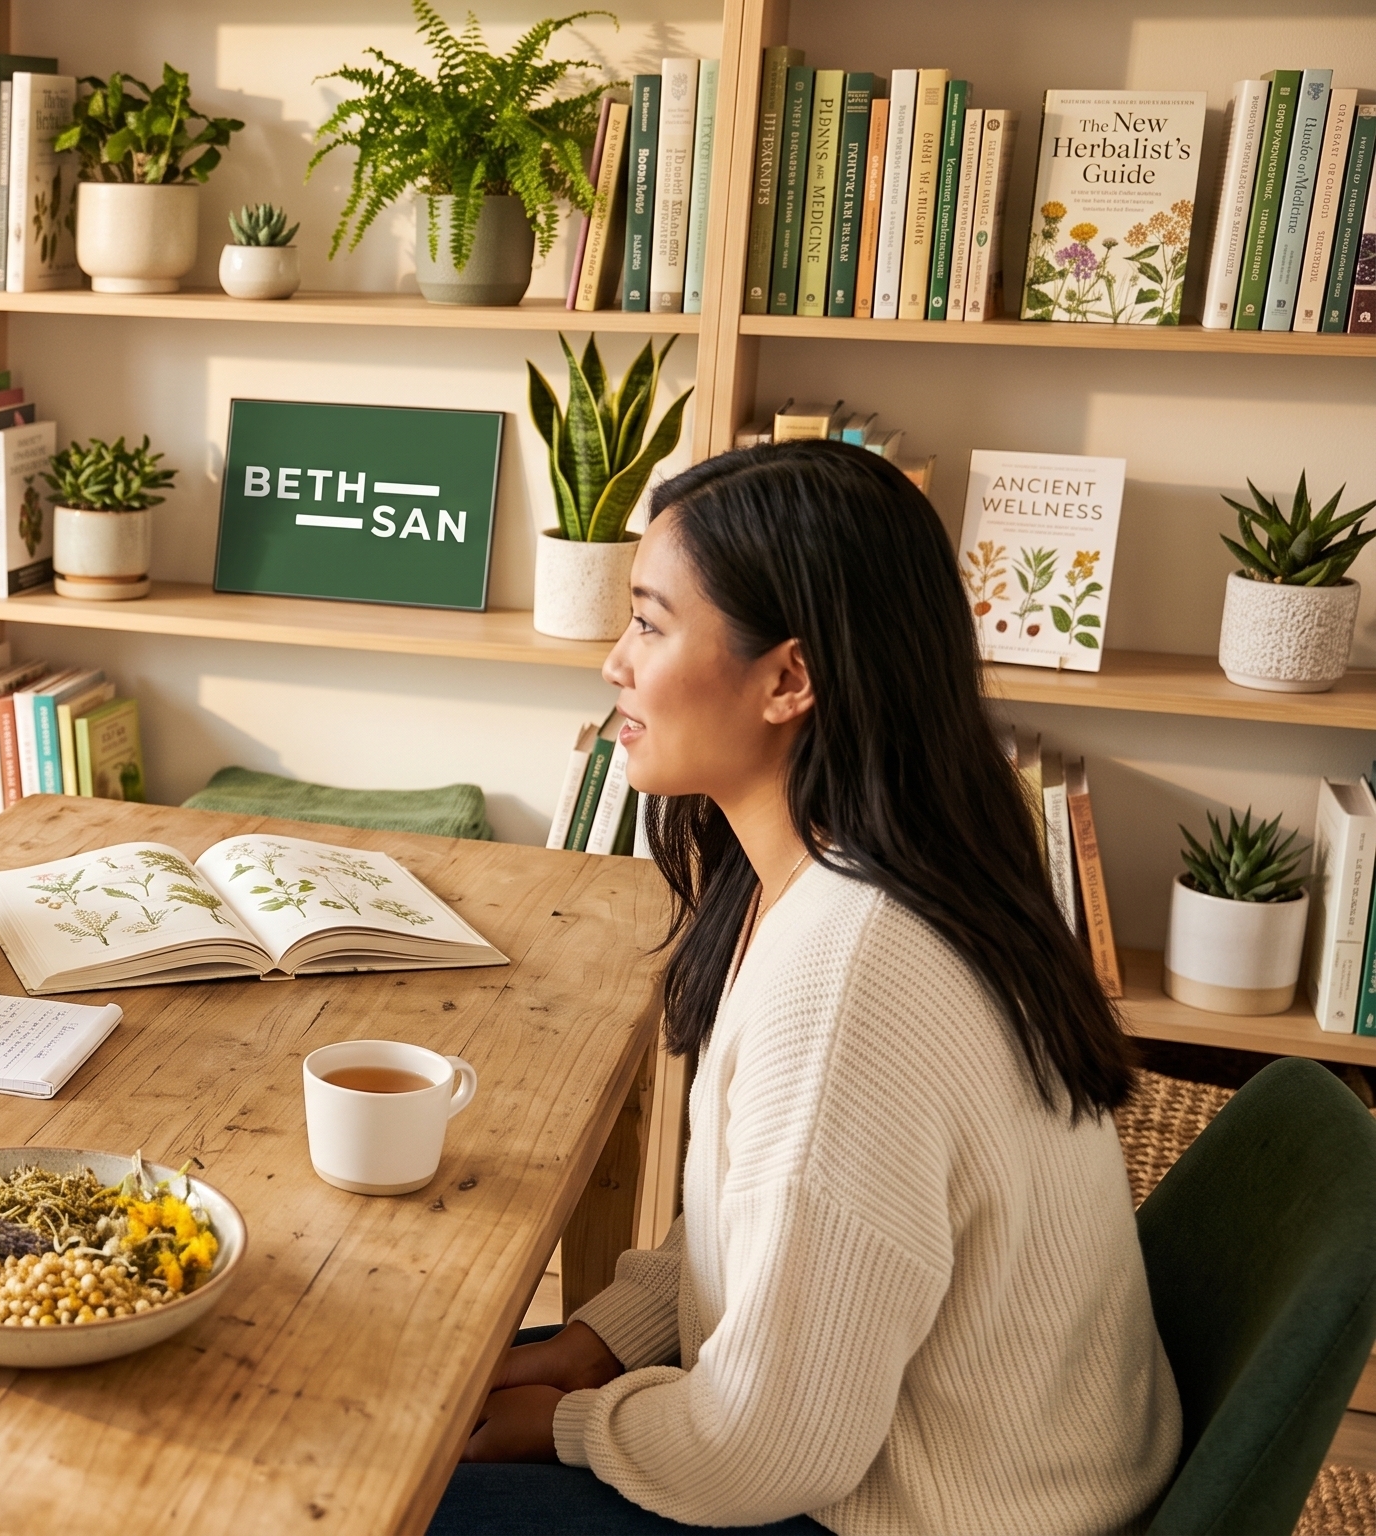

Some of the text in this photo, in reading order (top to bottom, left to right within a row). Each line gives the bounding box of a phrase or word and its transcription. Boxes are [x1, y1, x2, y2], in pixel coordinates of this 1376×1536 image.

[1079, 112, 1169, 133] The New
[1052, 137, 1191, 160] Herbalist's
[1082, 163, 1156, 184] Guide
[807, 185, 826, 263] MEDICINE
[243, 465, 366, 504] BETH
[992, 476, 1097, 497] ANCIENT
[982, 496, 1103, 521] WELLNESS
[370, 505, 467, 543] SAN
